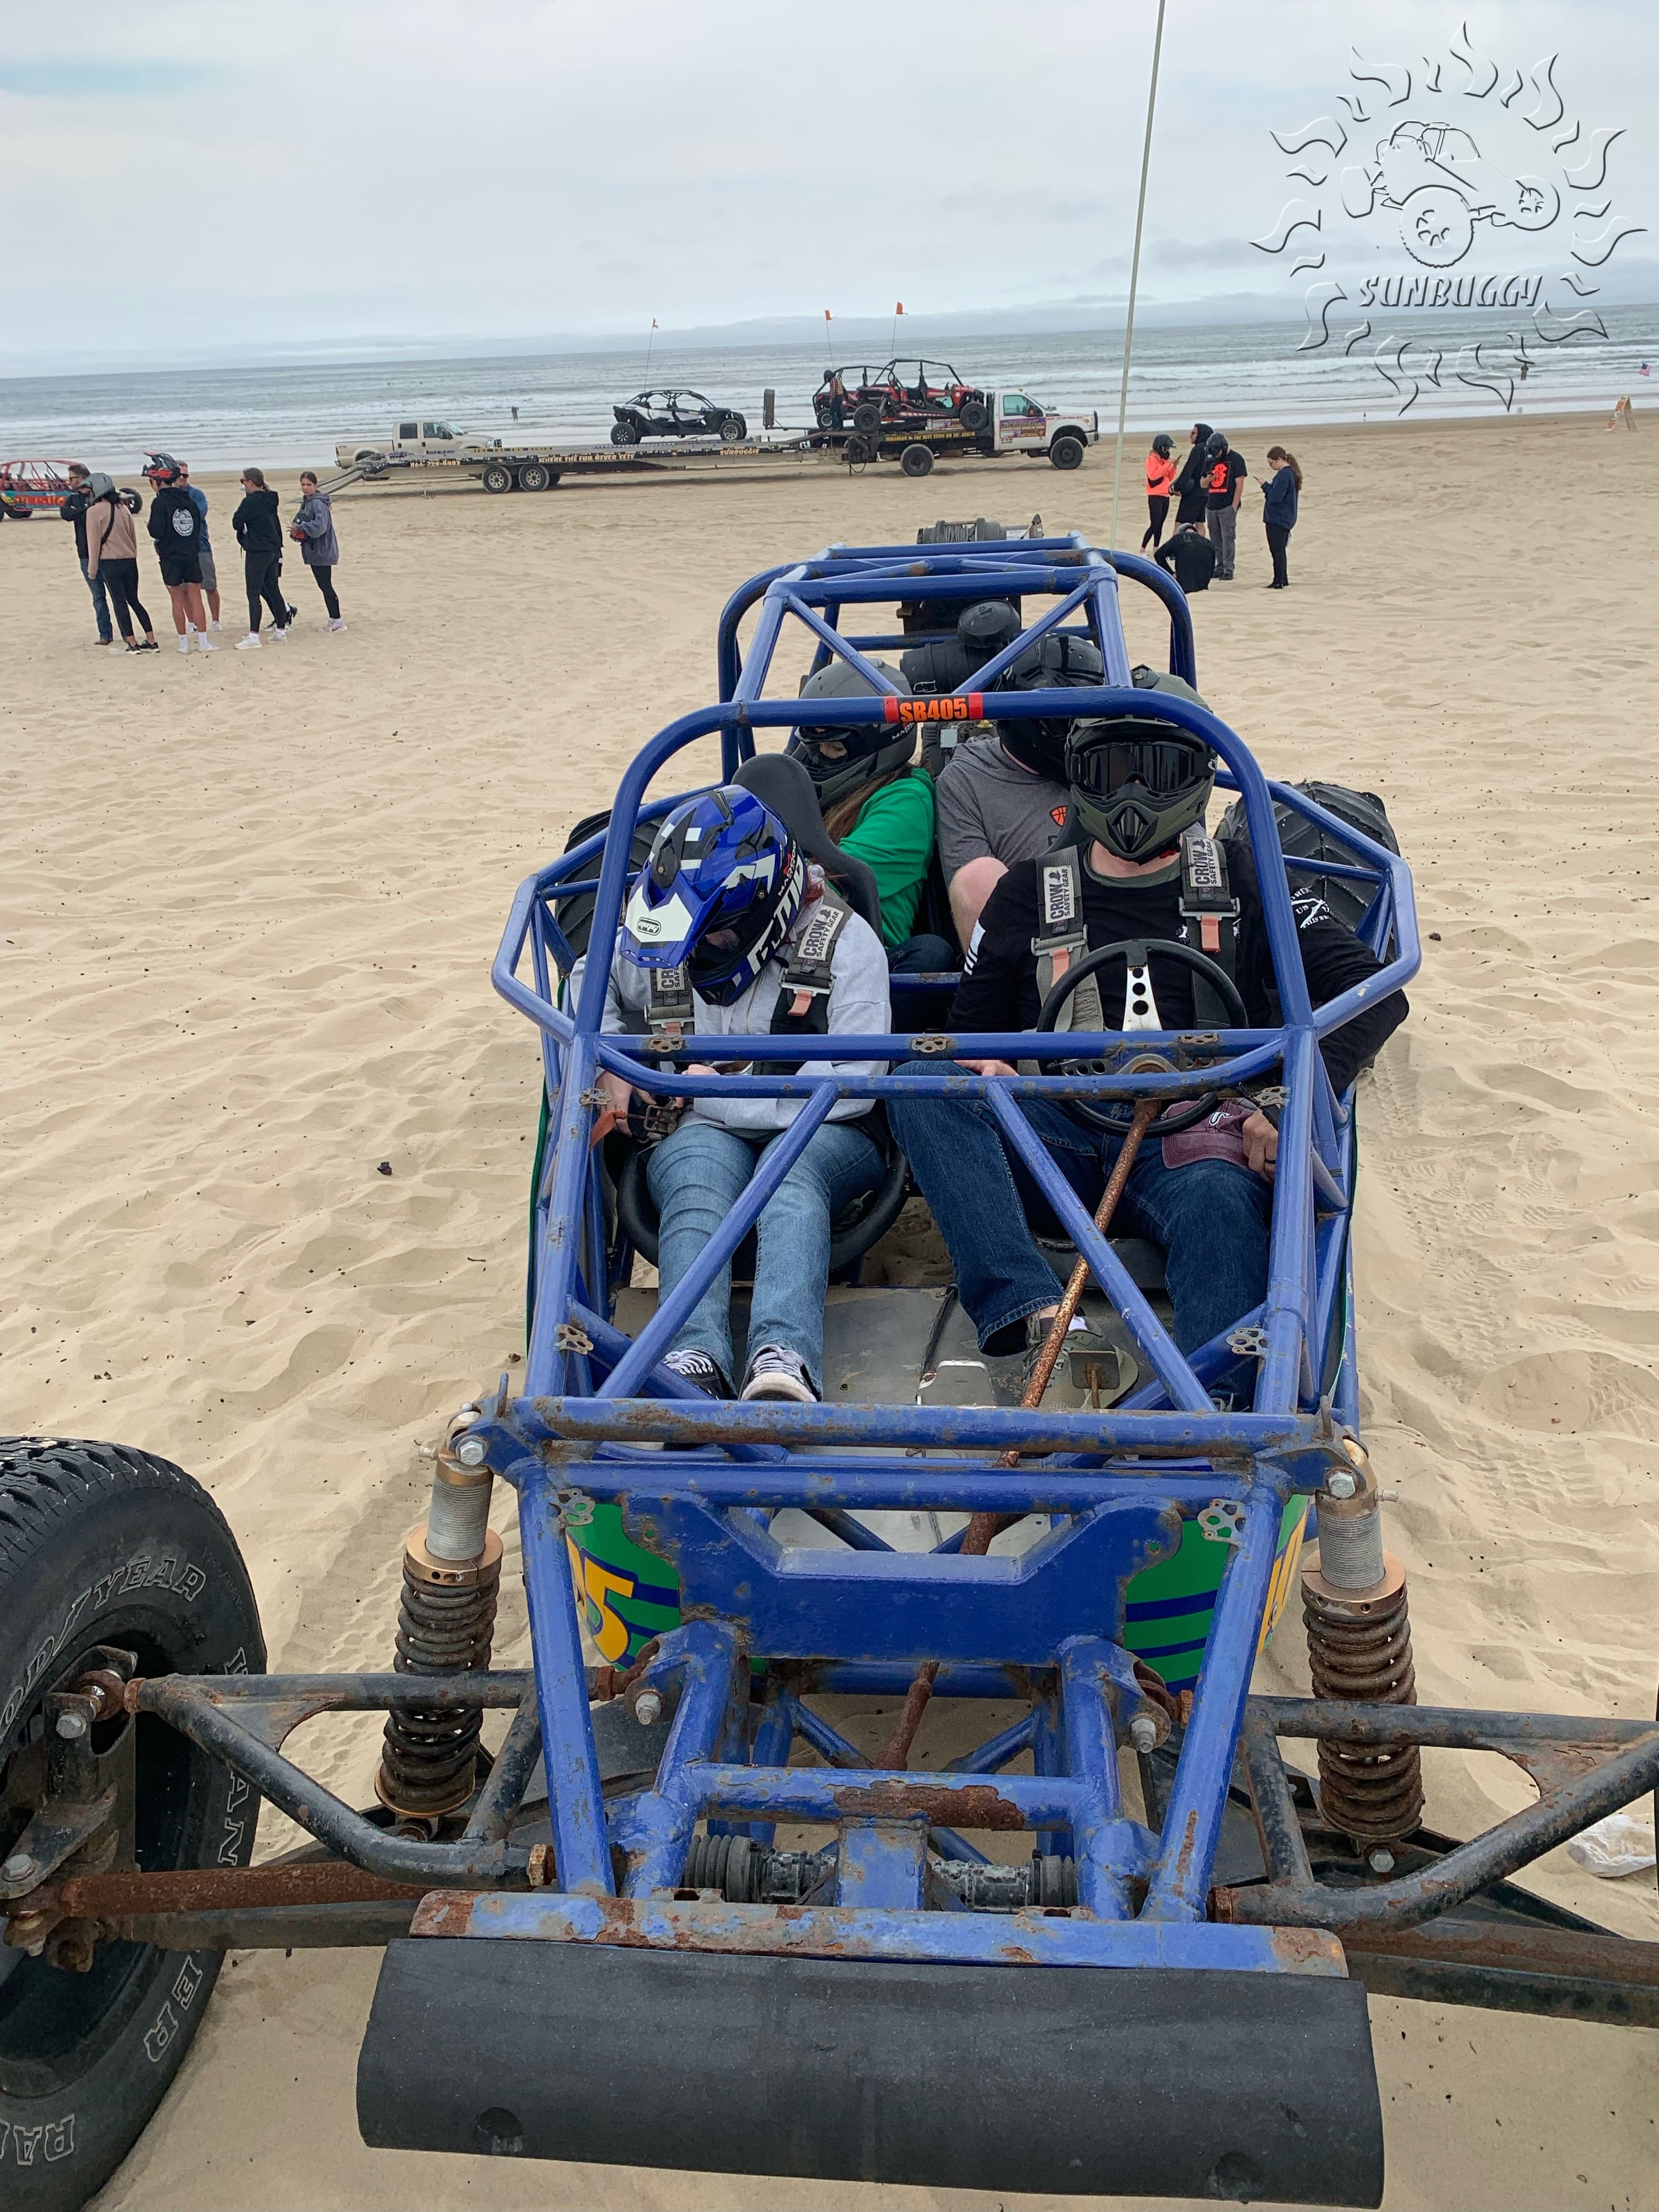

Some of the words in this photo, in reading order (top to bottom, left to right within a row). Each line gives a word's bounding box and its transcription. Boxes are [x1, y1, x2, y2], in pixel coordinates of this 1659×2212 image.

[900, 698, 967, 722] SB405
[1193, 850, 1210, 885] CROW
[1207, 857, 1217, 884] SAFETY
[1049, 883, 1064, 920] CROW
[803, 919, 828, 957] CROW
[816, 927, 831, 957] SAFETY
[827, 911, 840, 928] GEAR
[661, 969, 675, 989] CR
